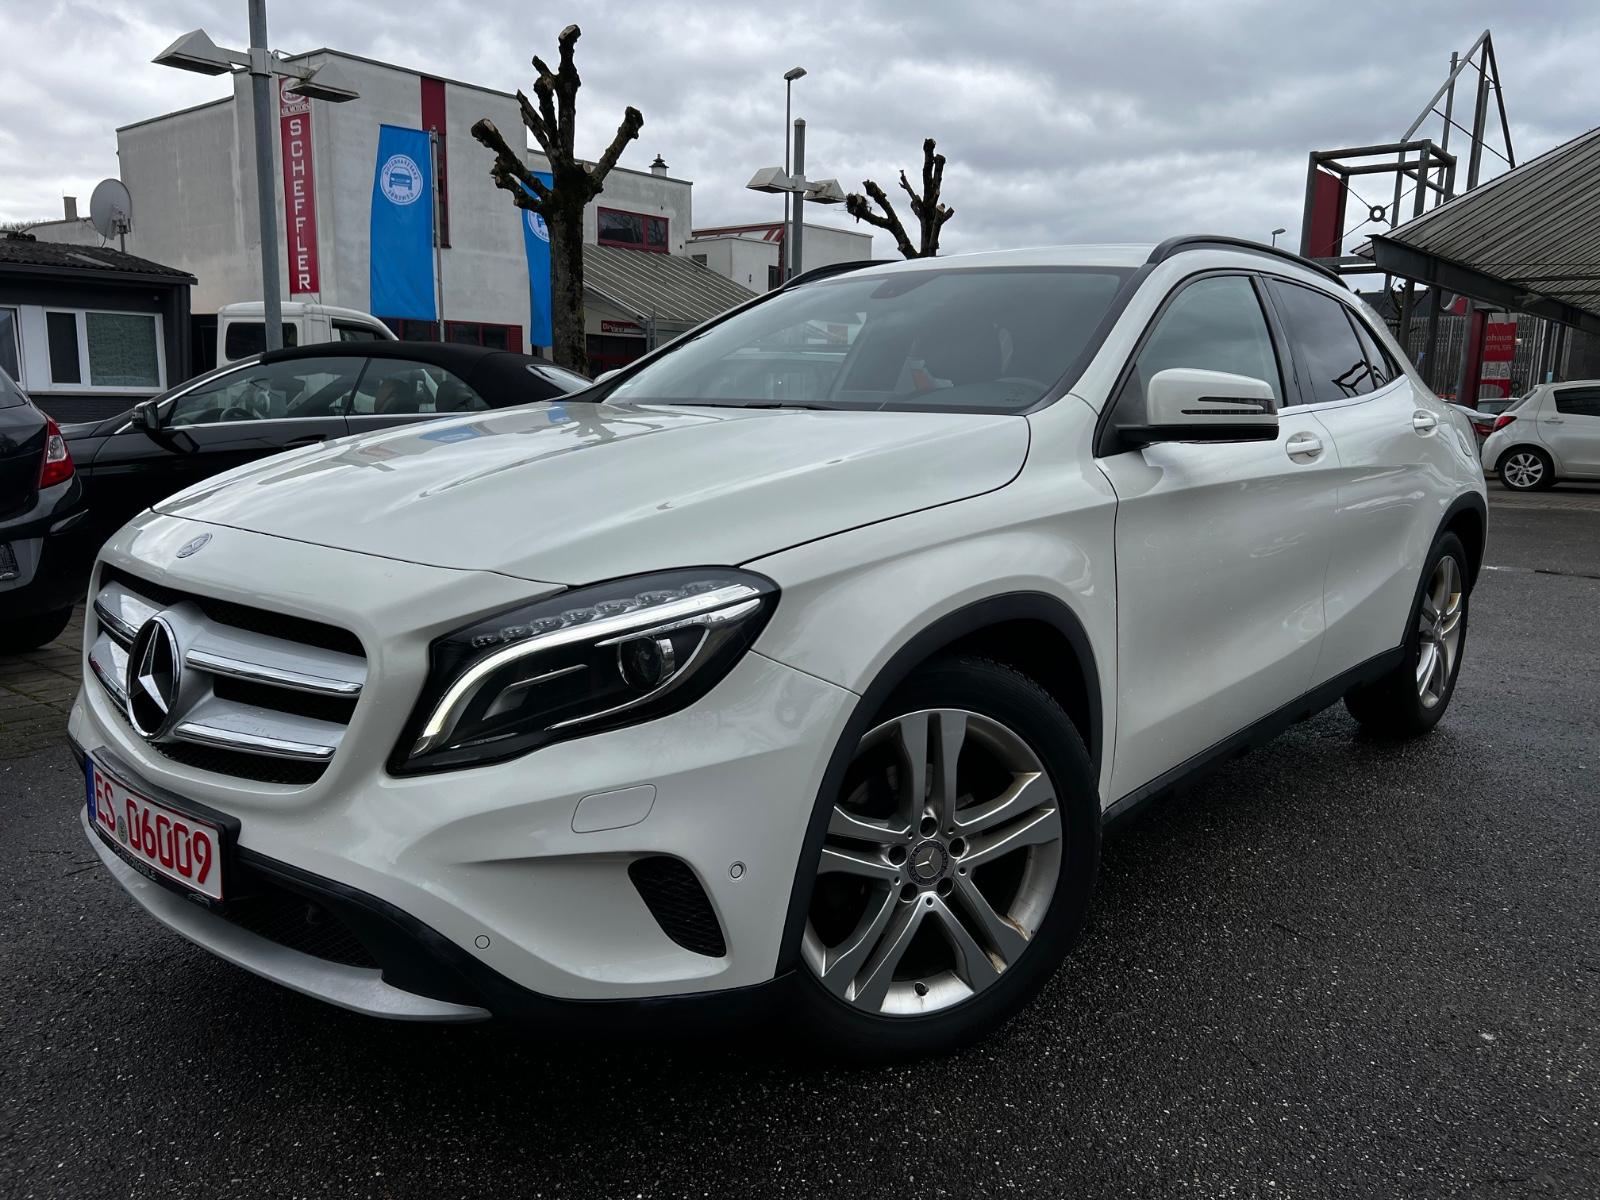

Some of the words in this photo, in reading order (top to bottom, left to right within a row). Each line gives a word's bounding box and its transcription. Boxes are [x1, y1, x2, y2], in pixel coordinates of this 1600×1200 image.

[289, 119, 311, 290] SCHEFFLER
[1487, 333, 1512, 341] ohaus
[95, 771, 116, 832] ES
[126, 798, 212, 885] 06009
